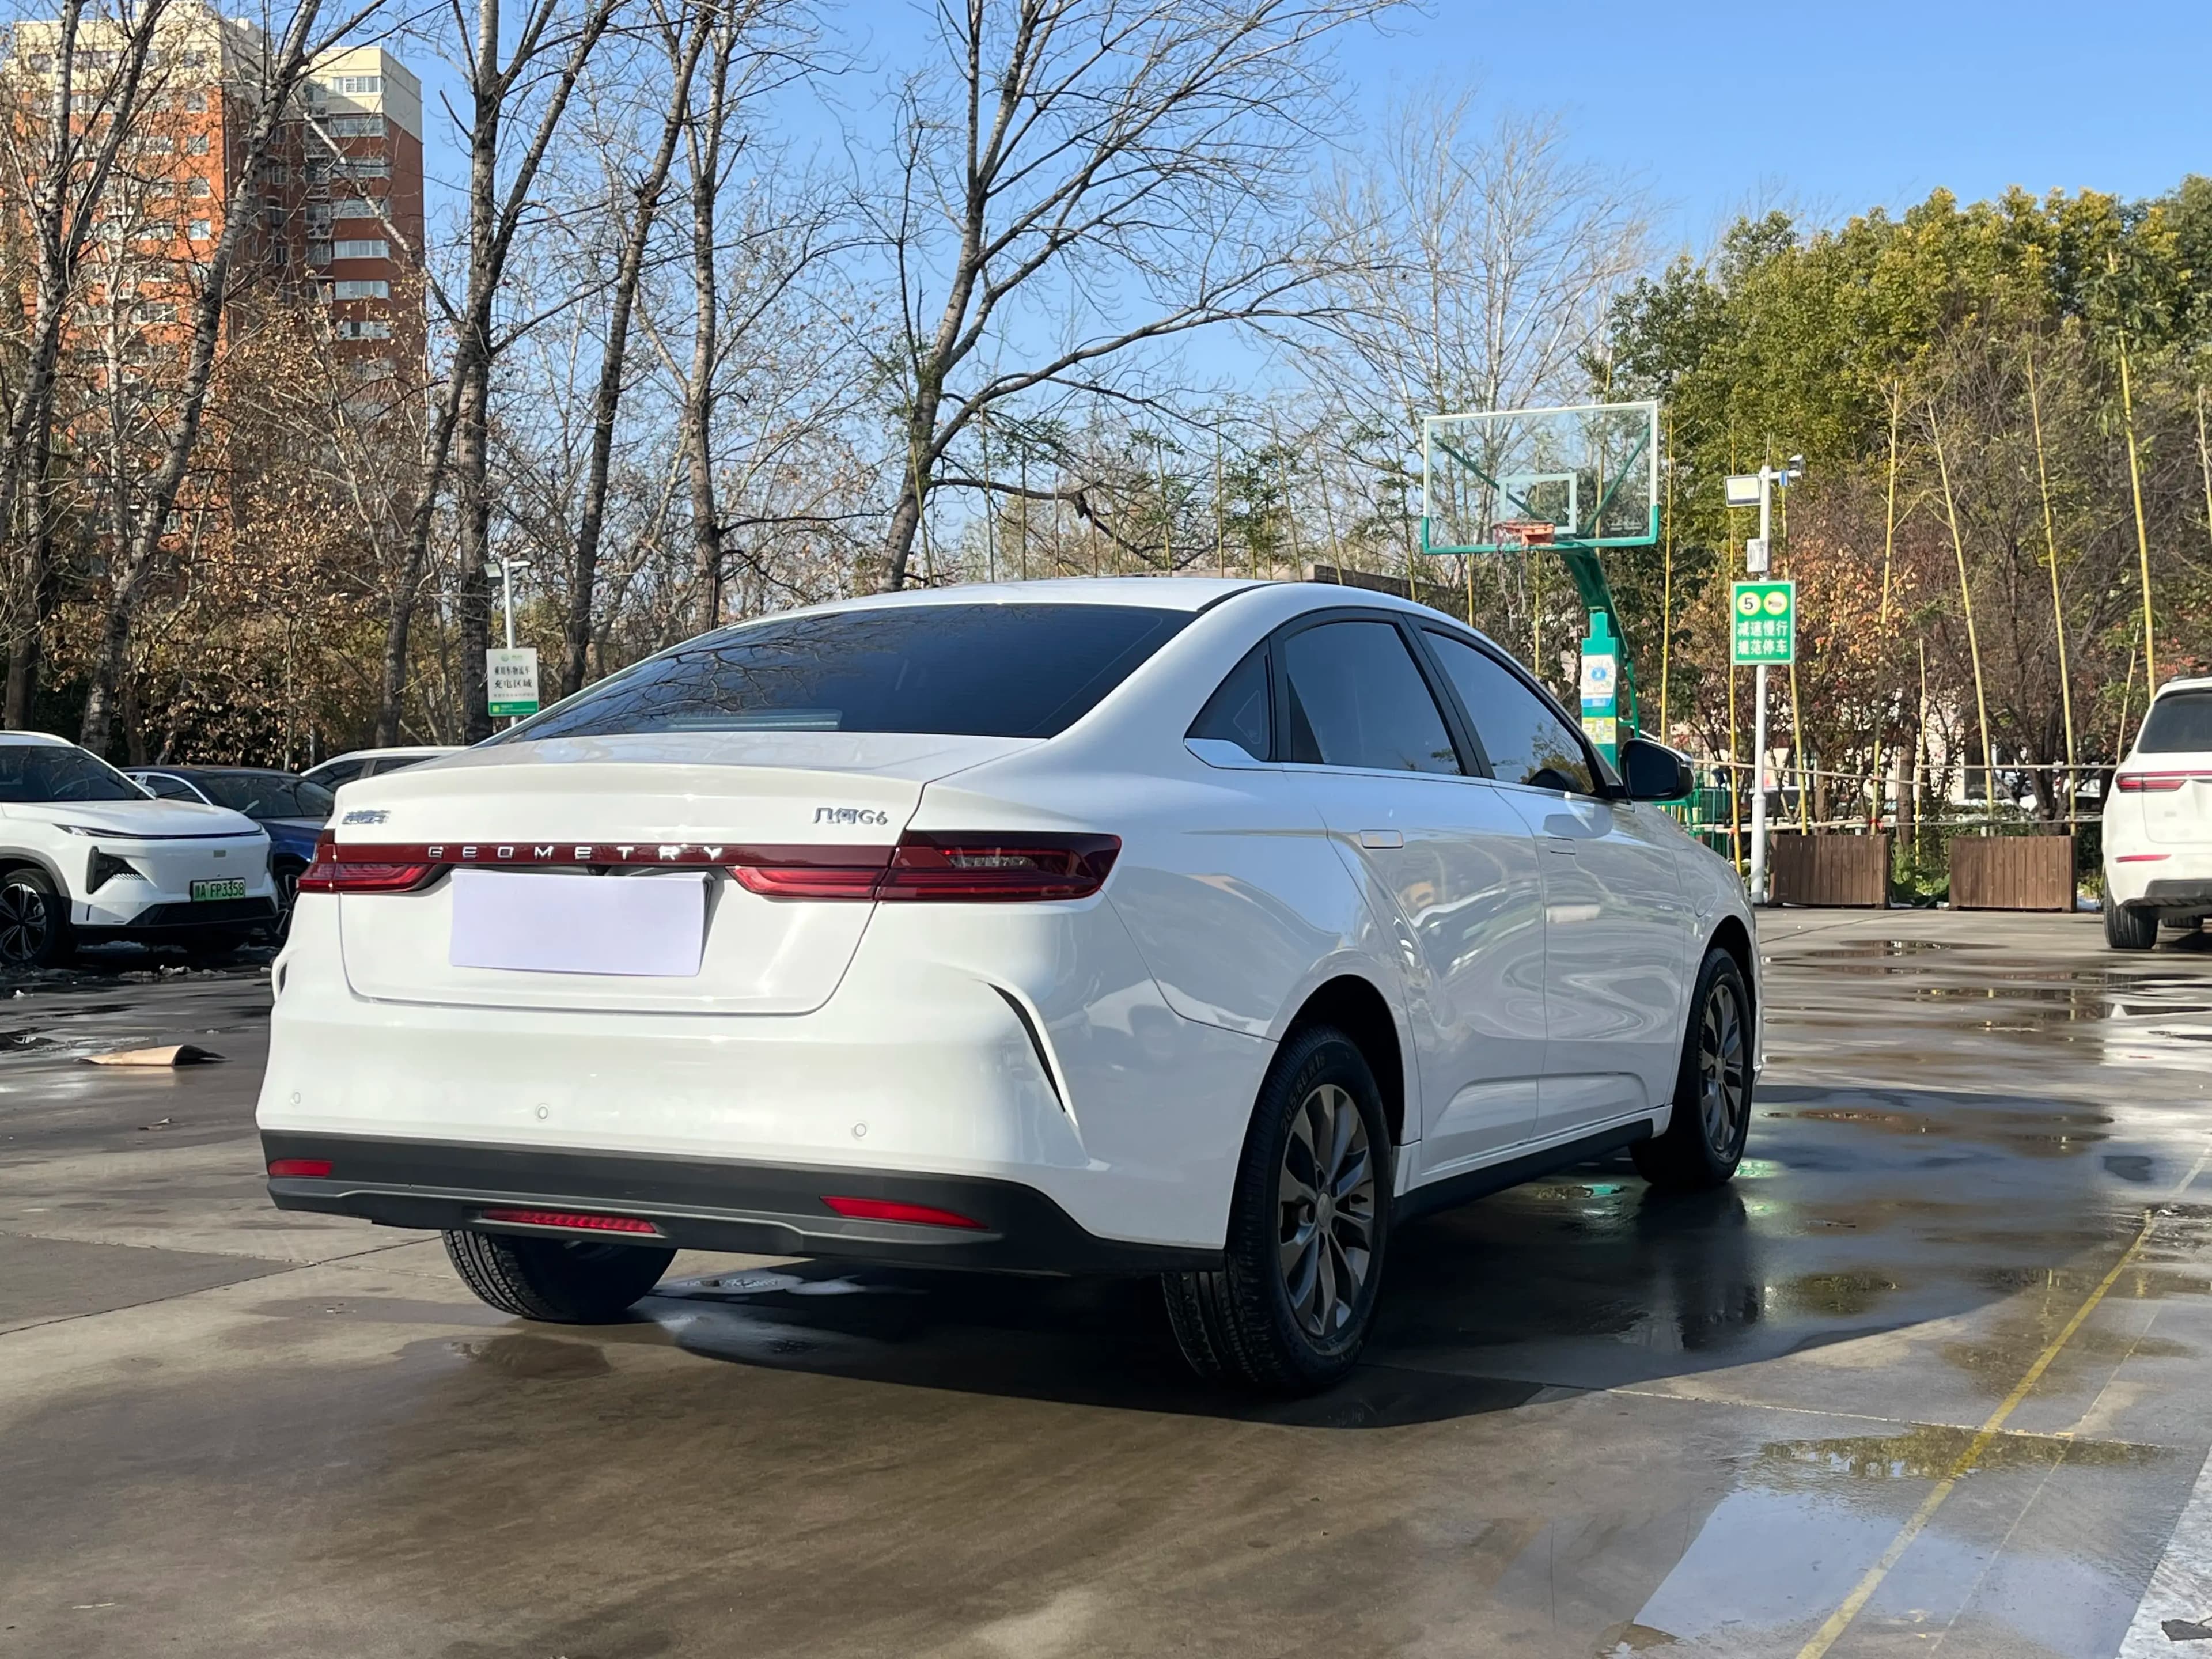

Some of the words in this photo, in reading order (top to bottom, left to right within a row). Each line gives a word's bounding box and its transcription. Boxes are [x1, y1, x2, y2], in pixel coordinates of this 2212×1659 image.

[1744, 597, 1753, 610] 5
[494, 679, 533, 689] 充电区域
[428, 844, 723, 861] GEOMETRY
